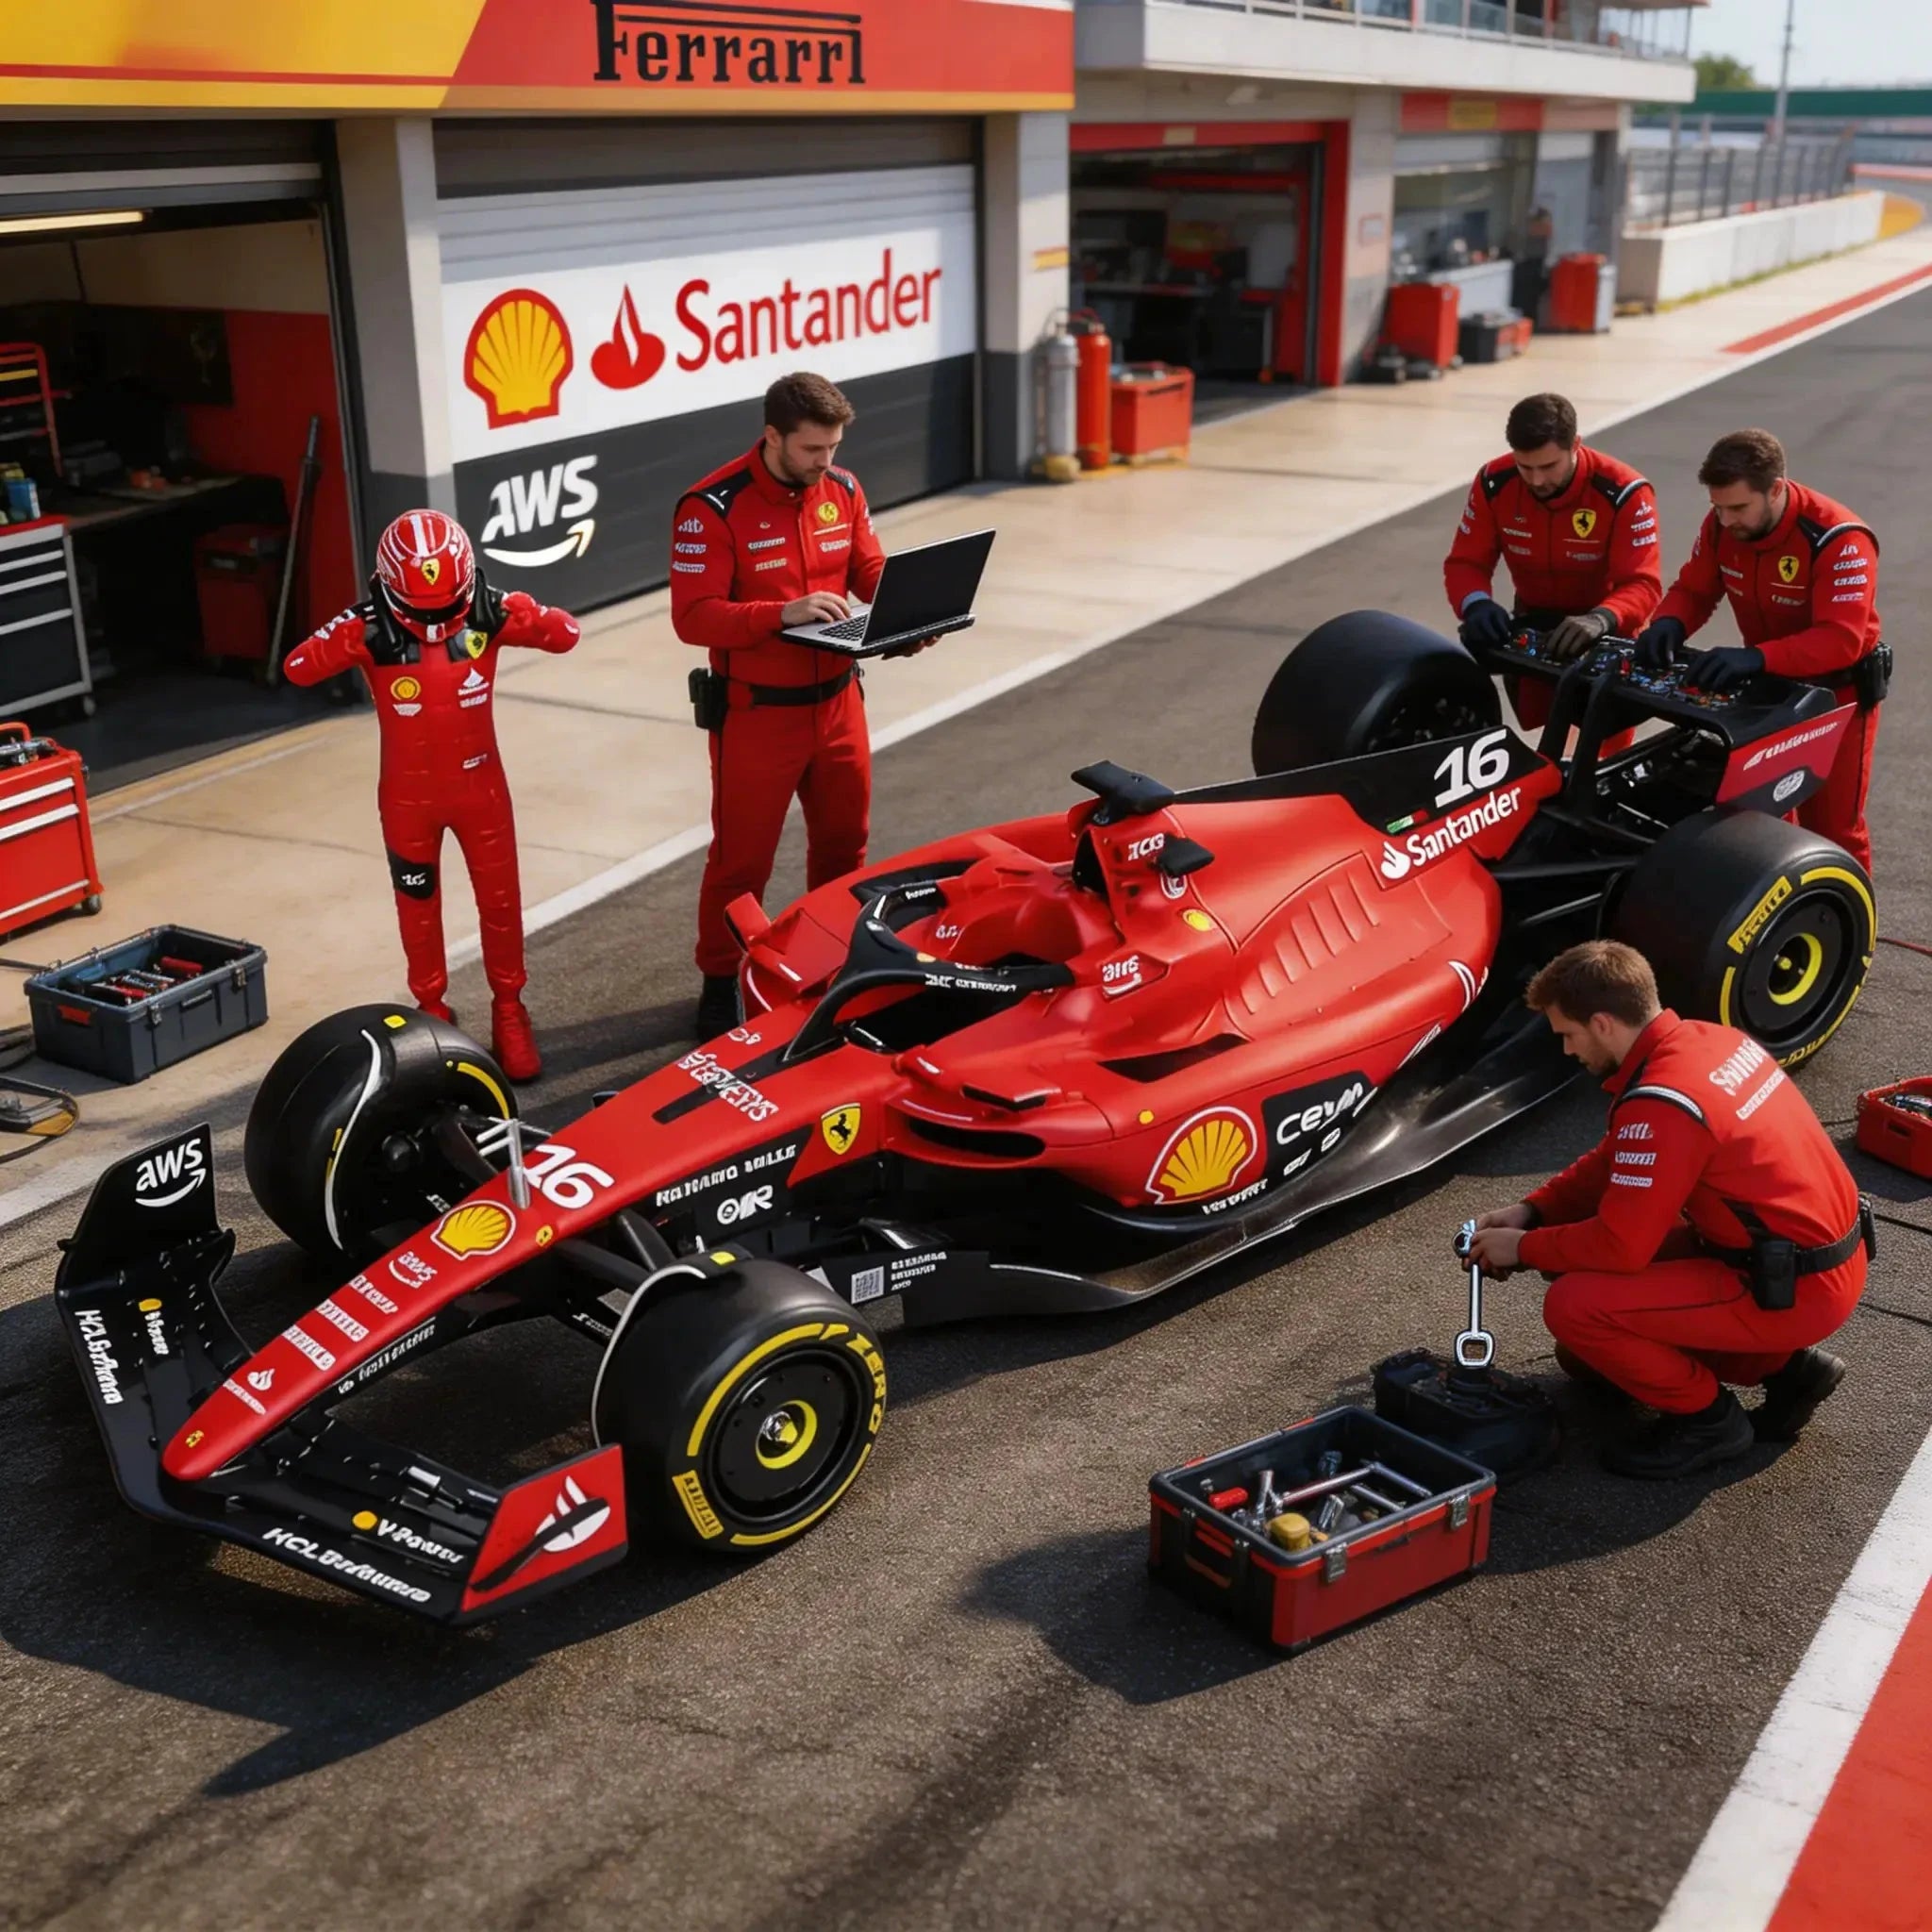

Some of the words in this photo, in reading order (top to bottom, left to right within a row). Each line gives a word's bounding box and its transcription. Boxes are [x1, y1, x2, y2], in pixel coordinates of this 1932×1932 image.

[675, 248, 942, 372] Santander
[1434, 728, 1509, 808] 16
[1407, 787, 1521, 866] Santander
[525, 1144, 614, 1208] 16
